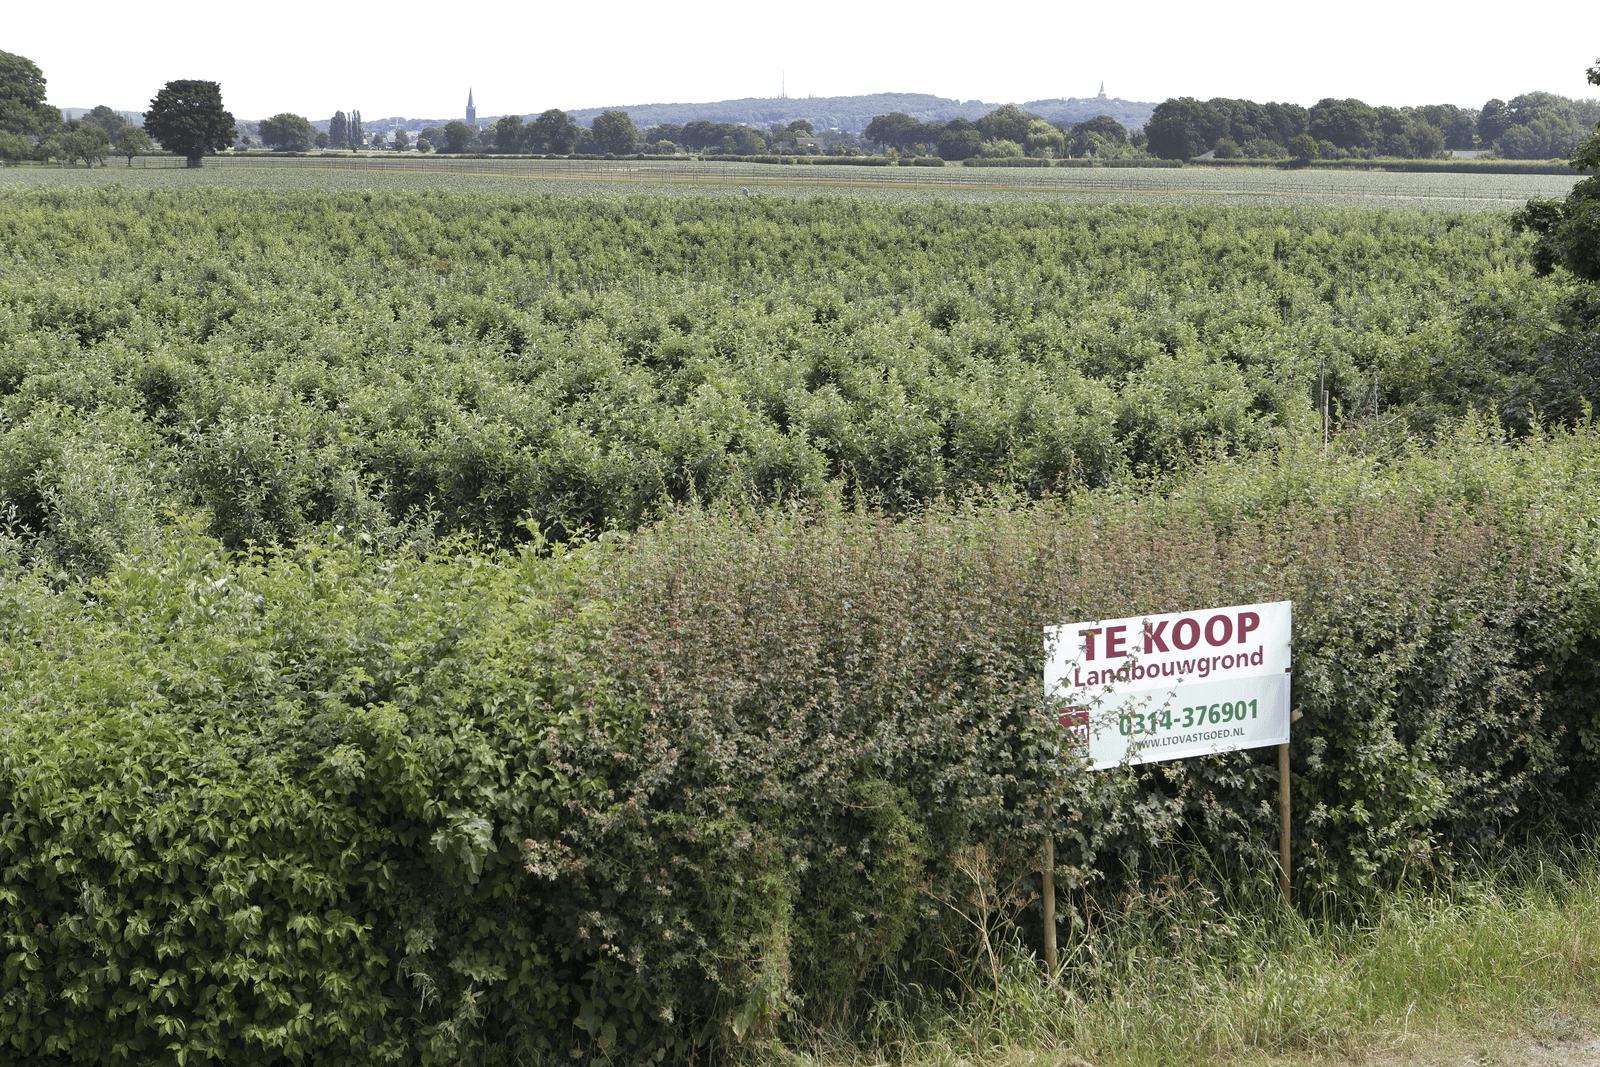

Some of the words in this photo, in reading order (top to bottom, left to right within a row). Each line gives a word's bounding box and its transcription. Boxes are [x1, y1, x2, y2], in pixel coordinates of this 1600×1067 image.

[1078, 625, 1127, 661] TE
[1143, 611, 1260, 655] KOOP
[1074, 645, 1264, 687] Landbouwgrond
[1119, 699, 1258, 736] 0314-376901
